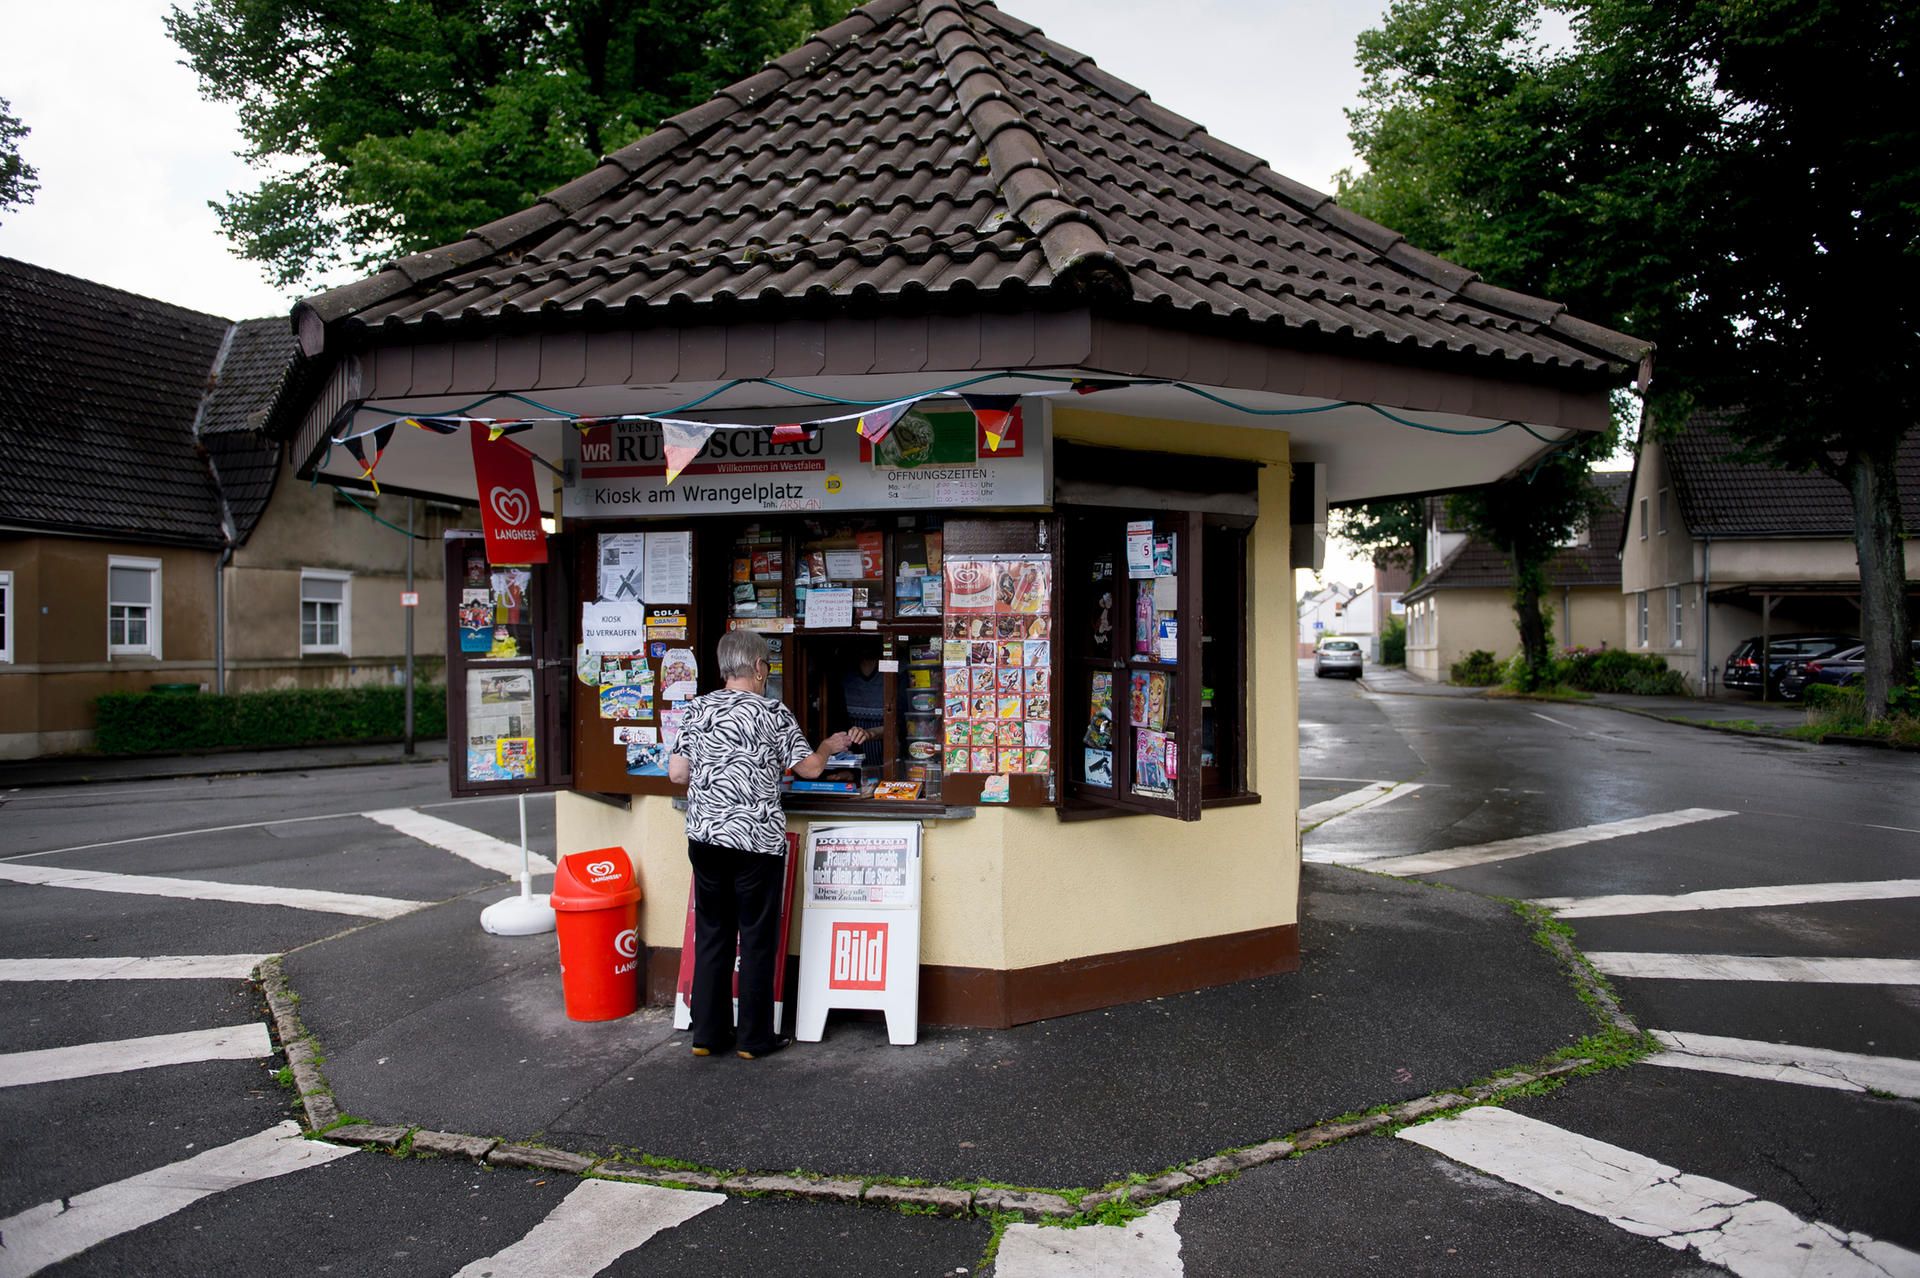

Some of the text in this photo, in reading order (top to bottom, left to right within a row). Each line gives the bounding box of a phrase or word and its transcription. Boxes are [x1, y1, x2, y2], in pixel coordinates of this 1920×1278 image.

[582, 443, 611, 461] WR
[718, 460, 823, 473] Willkommen in Westfalen.
[595, 482, 803, 505] Kiosk am Wrangelplatz
[763, 501, 778, 509] Inh.
[495, 528, 537, 541] LANGNESE
[1143, 545, 1150, 556] 5
[653, 609, 680, 617] COLA
[586, 629, 637, 637] ZU VERKAUFEN
[592, 874, 620, 883] LANGNESE
[814, 866, 831, 884] nicht
[832, 867, 852, 884] allein
[852, 867, 865, 884] auf
[865, 867, 876, 884] die
[815, 893, 837, 901] haben
[834, 929, 884, 982] Bild
[615, 961, 637, 975] LANG
